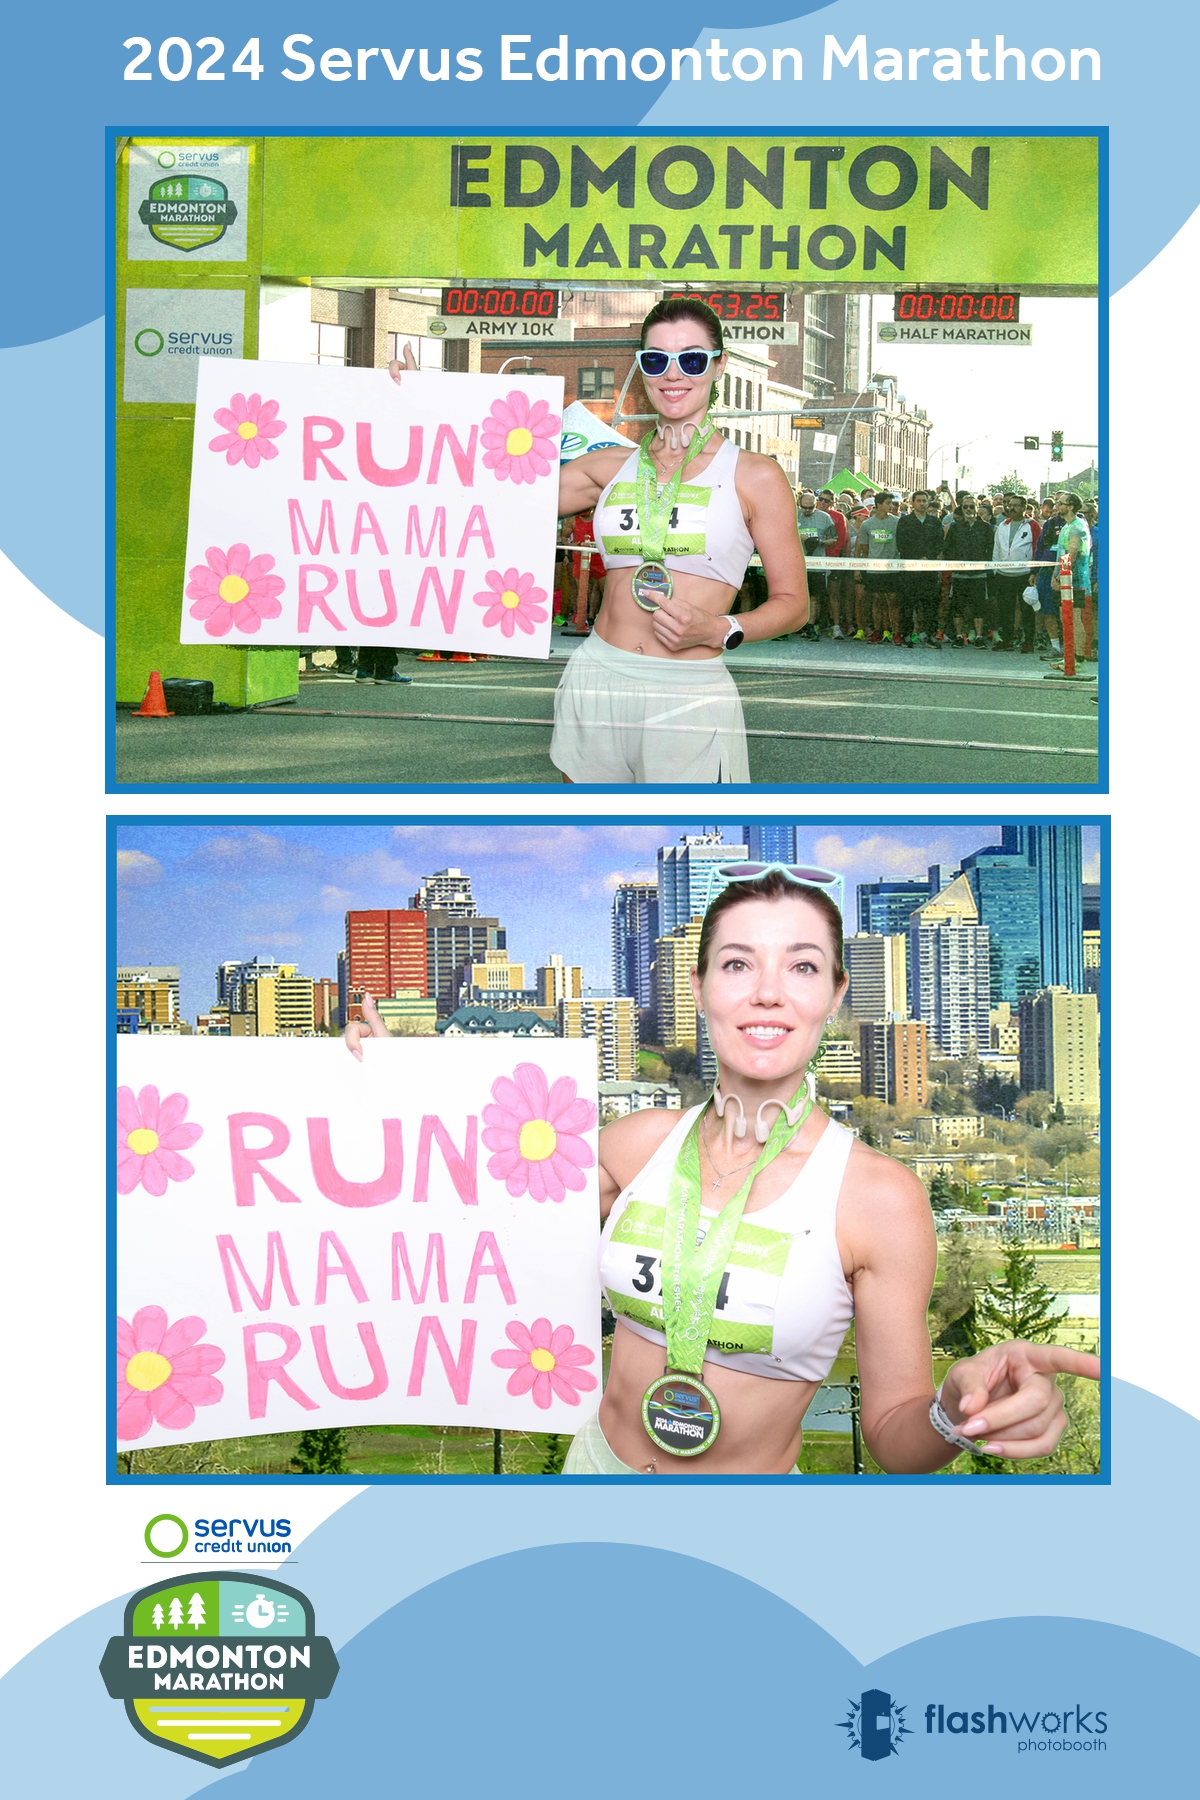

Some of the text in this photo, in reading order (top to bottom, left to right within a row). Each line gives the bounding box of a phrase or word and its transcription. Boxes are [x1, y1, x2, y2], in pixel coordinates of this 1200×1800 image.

[178, 152, 219, 161] servus
[449, 144, 991, 211] EDMONTON
[149, 203, 227, 214] EDMONTON
[160, 214, 215, 222] MARATHON
[523, 222, 907, 272] MARATHON
[168, 332, 233, 345] servus
[466, 321, 554, 336] ARMY 10K
[723, 326, 785, 340] ATHON
[900, 328, 1030, 341] HALF MARATHON
[167, 345, 233, 355] credit union
[302, 414, 479, 487] RUN
[287, 498, 495, 559] MAMA
[619, 507, 679, 531] 34
[297, 563, 466, 634] RUN
[228, 1112, 478, 1208] RUN
[674, 1208, 687, 1259] MARATHON
[216, 1231, 517, 1313] MAMA
[672, 1264, 682, 1312] FINISHER
[707, 1338, 743, 1349] ATHON
[242, 1316, 477, 1420] RUN
[654, 1419, 705, 1440] MARATHON
[672, 1419, 705, 1431] EDMONTON
